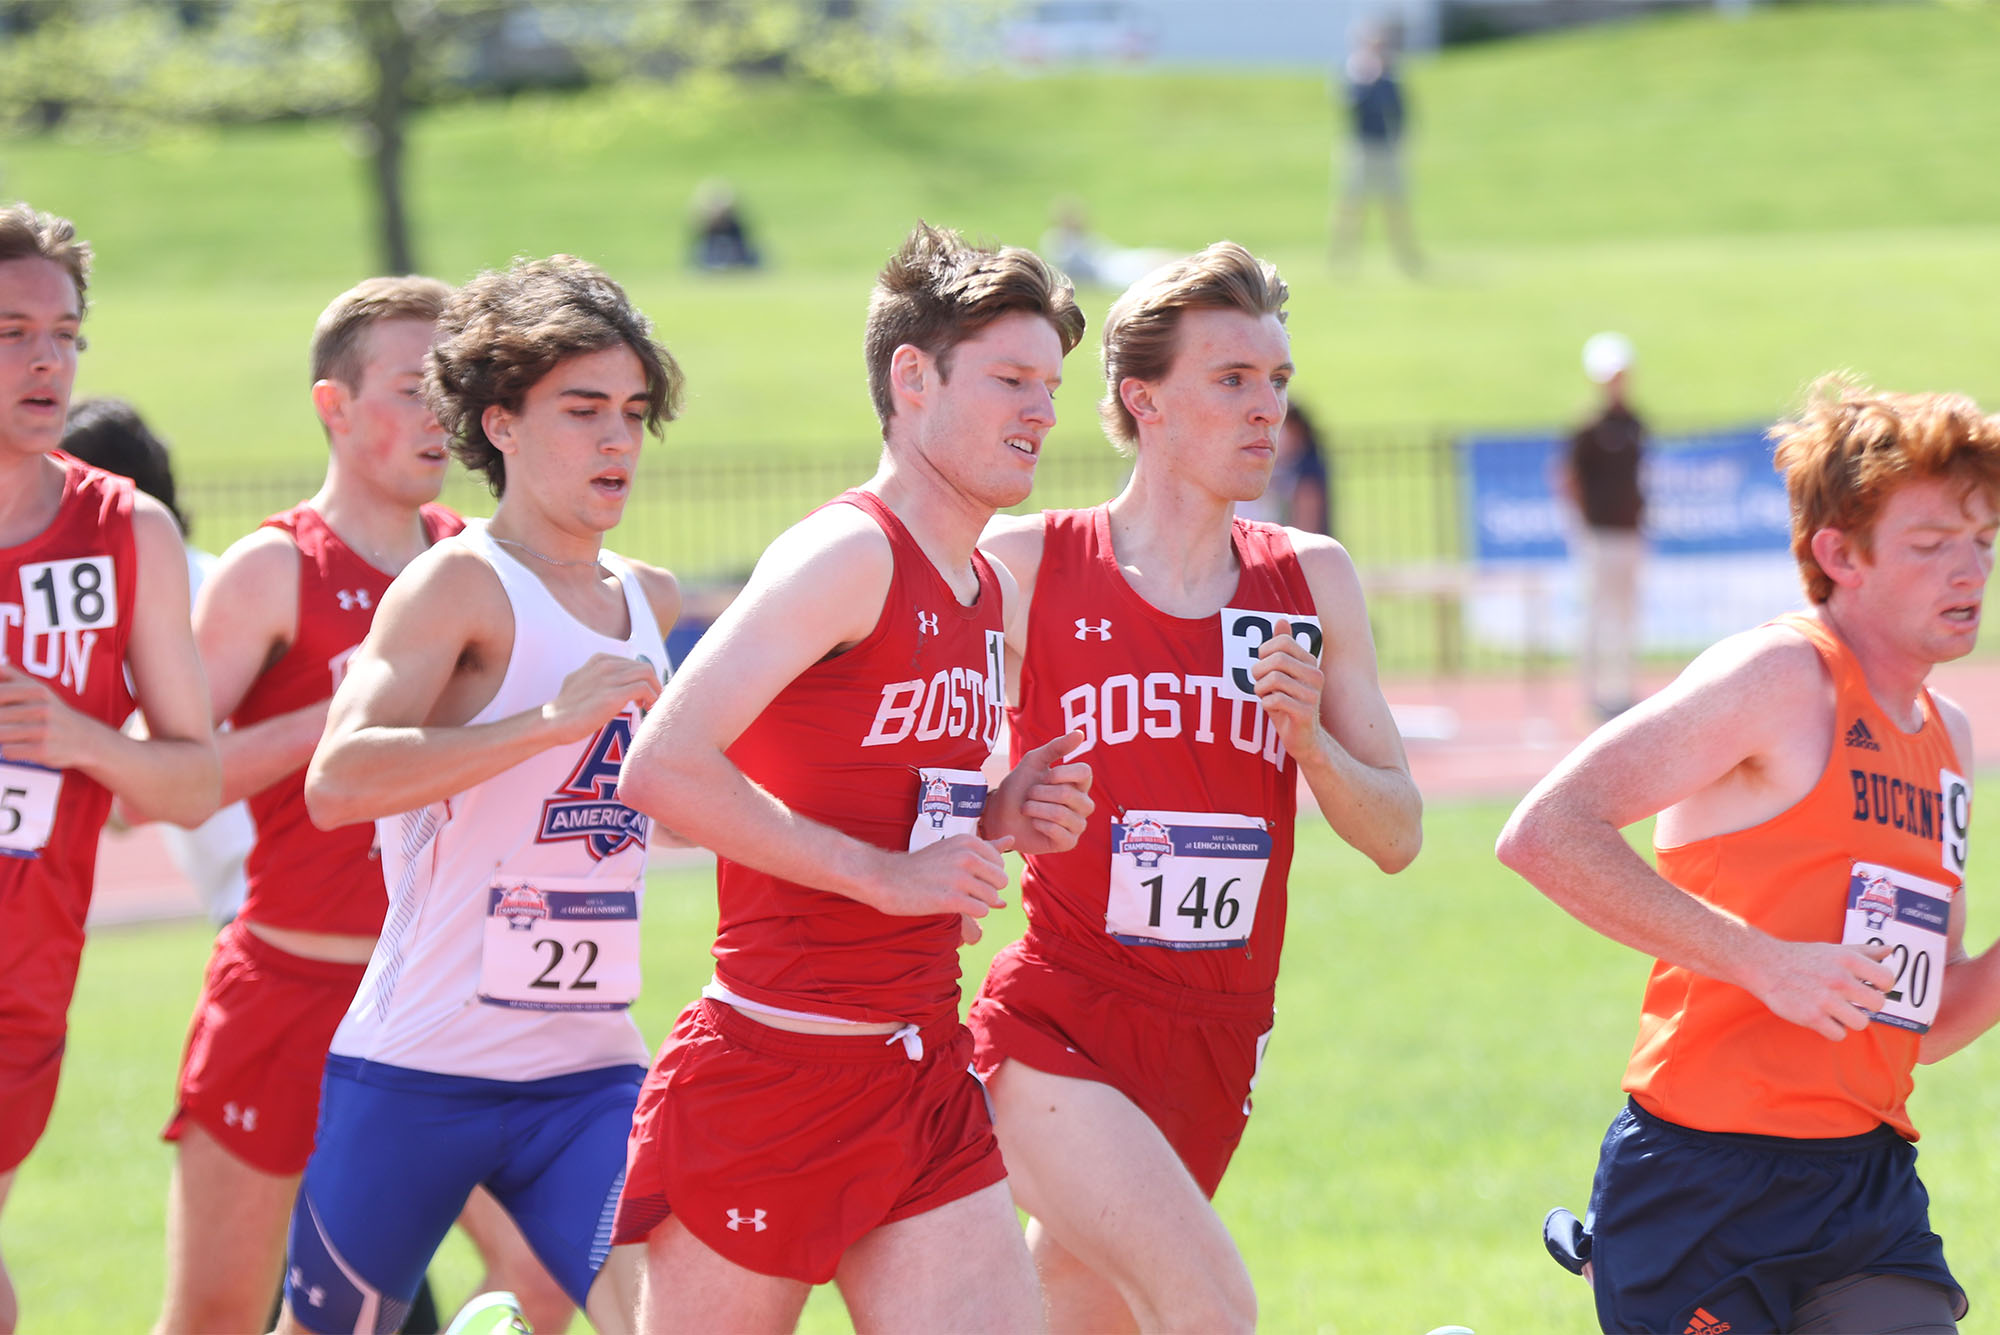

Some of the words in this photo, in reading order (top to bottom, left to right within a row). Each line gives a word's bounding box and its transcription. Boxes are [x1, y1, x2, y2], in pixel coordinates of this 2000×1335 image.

[32, 563, 105, 625] 18
[1193, 842, 1220, 850] LEHIGH
[1222, 843, 1259, 851] UNIVERSITY
[1950, 782, 1967, 872] 9
[1140, 875, 1241, 929] 146
[528, 939, 599, 990] 22
